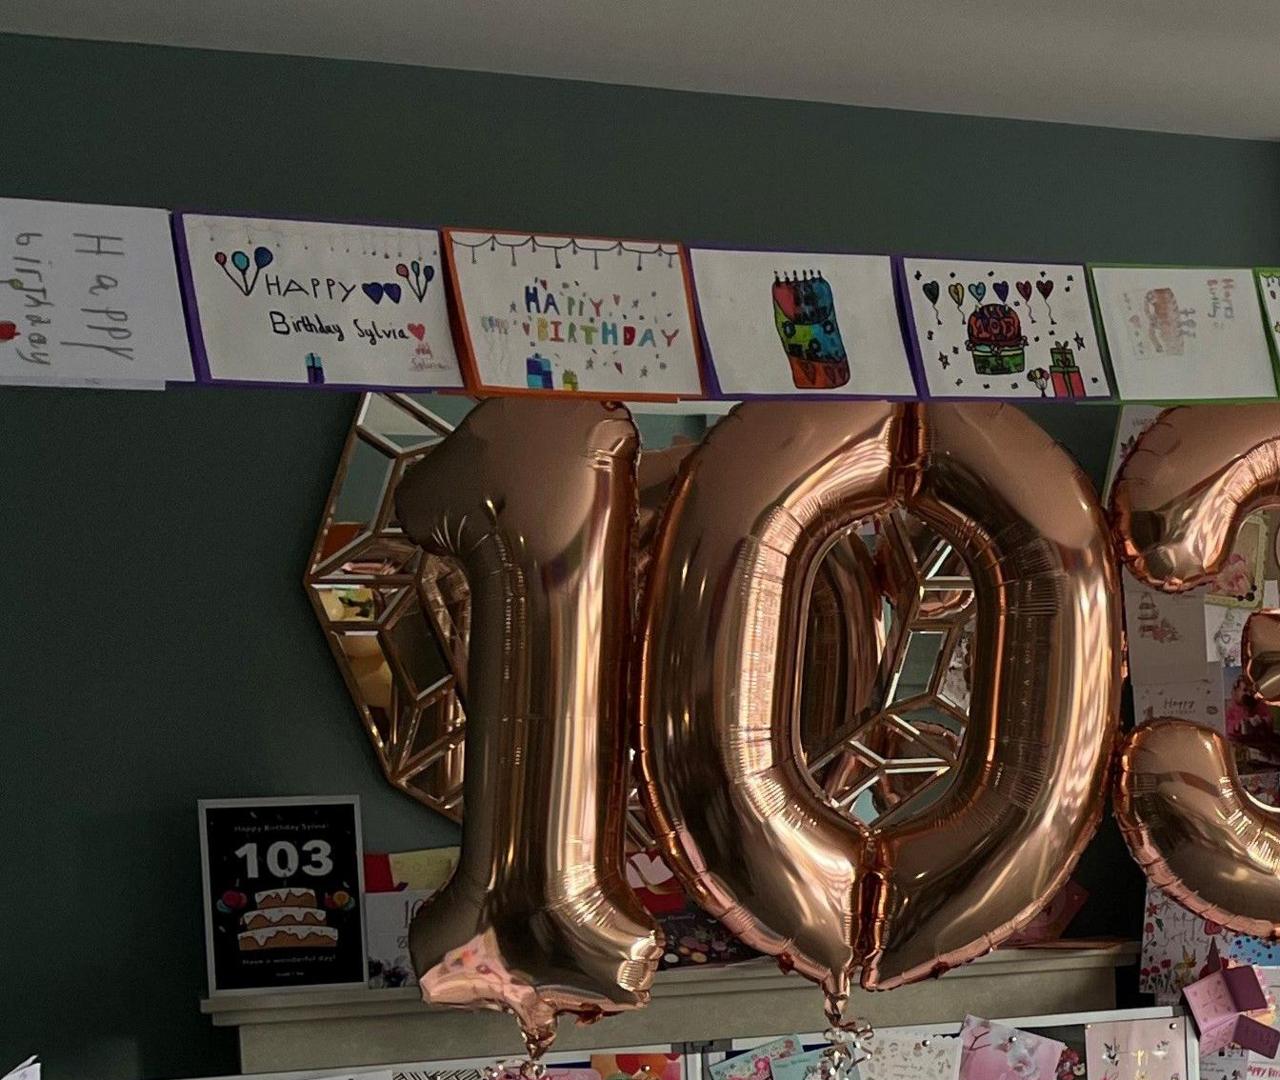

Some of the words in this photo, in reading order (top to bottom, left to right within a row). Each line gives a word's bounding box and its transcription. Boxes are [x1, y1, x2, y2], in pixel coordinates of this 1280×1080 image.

[60, 232, 135, 361] Happy
[263, 273, 358, 303] HAPPY
[524, 285, 604, 318] HAPPY
[268, 310, 345, 342] Birthday
[352, 318, 410, 346] Sylvia
[536, 316, 680, 349] BIRTHDAY
[233, 839, 334, 879] 103
